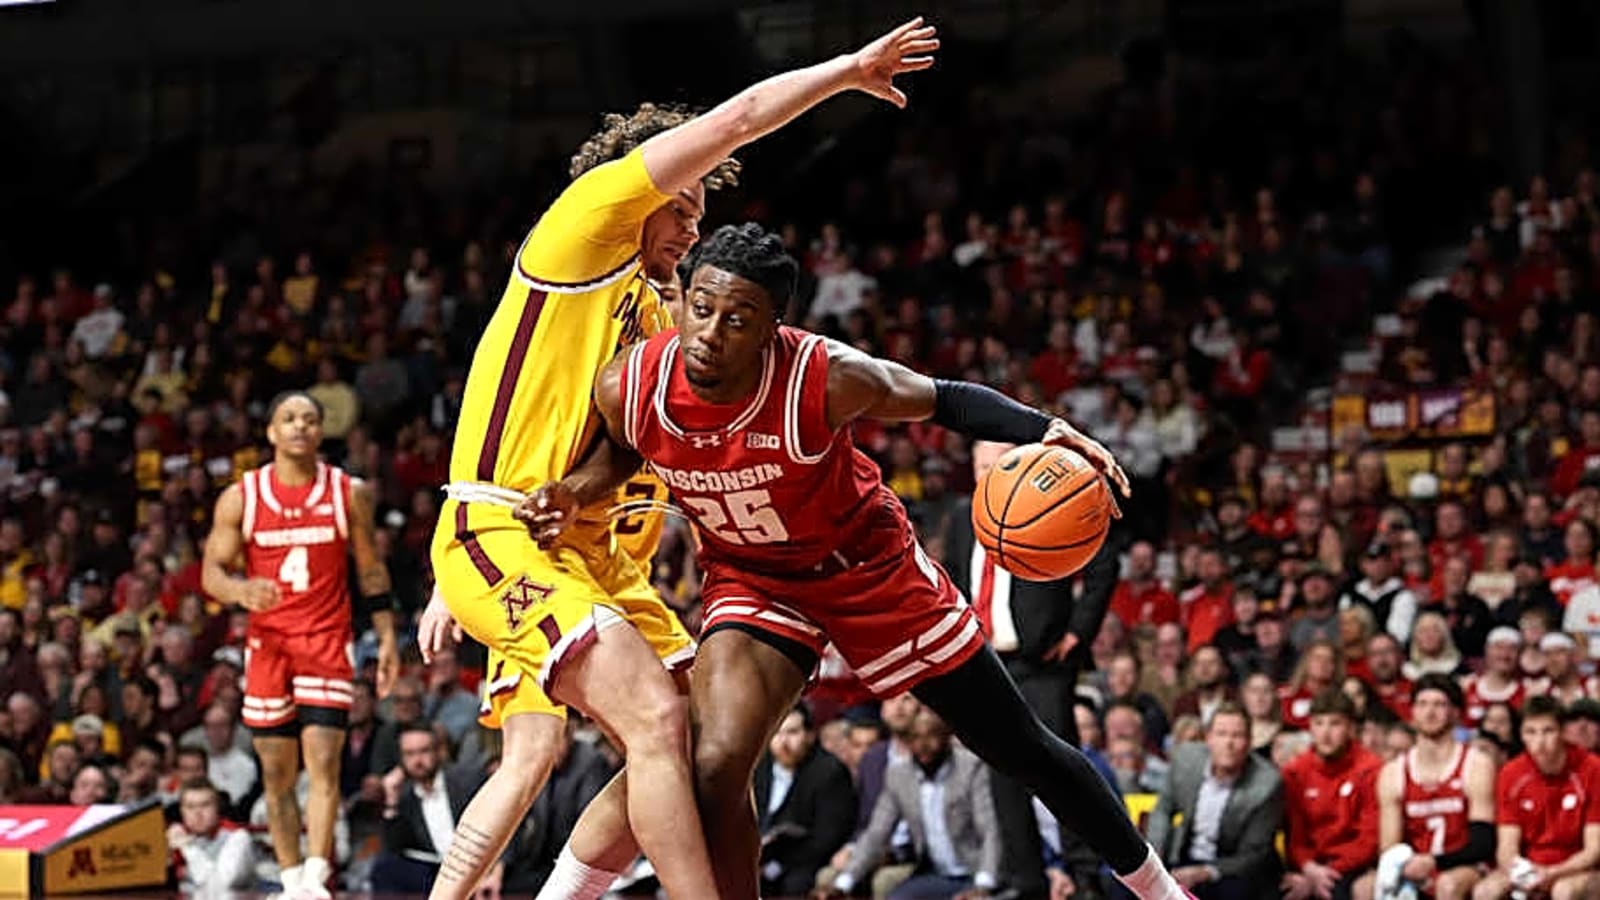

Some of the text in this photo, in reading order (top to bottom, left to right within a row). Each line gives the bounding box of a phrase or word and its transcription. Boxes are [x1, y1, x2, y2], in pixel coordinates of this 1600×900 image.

[682, 489, 789, 545] 25
[280, 546, 310, 593] 4
[1426, 816, 1447, 856] 7
